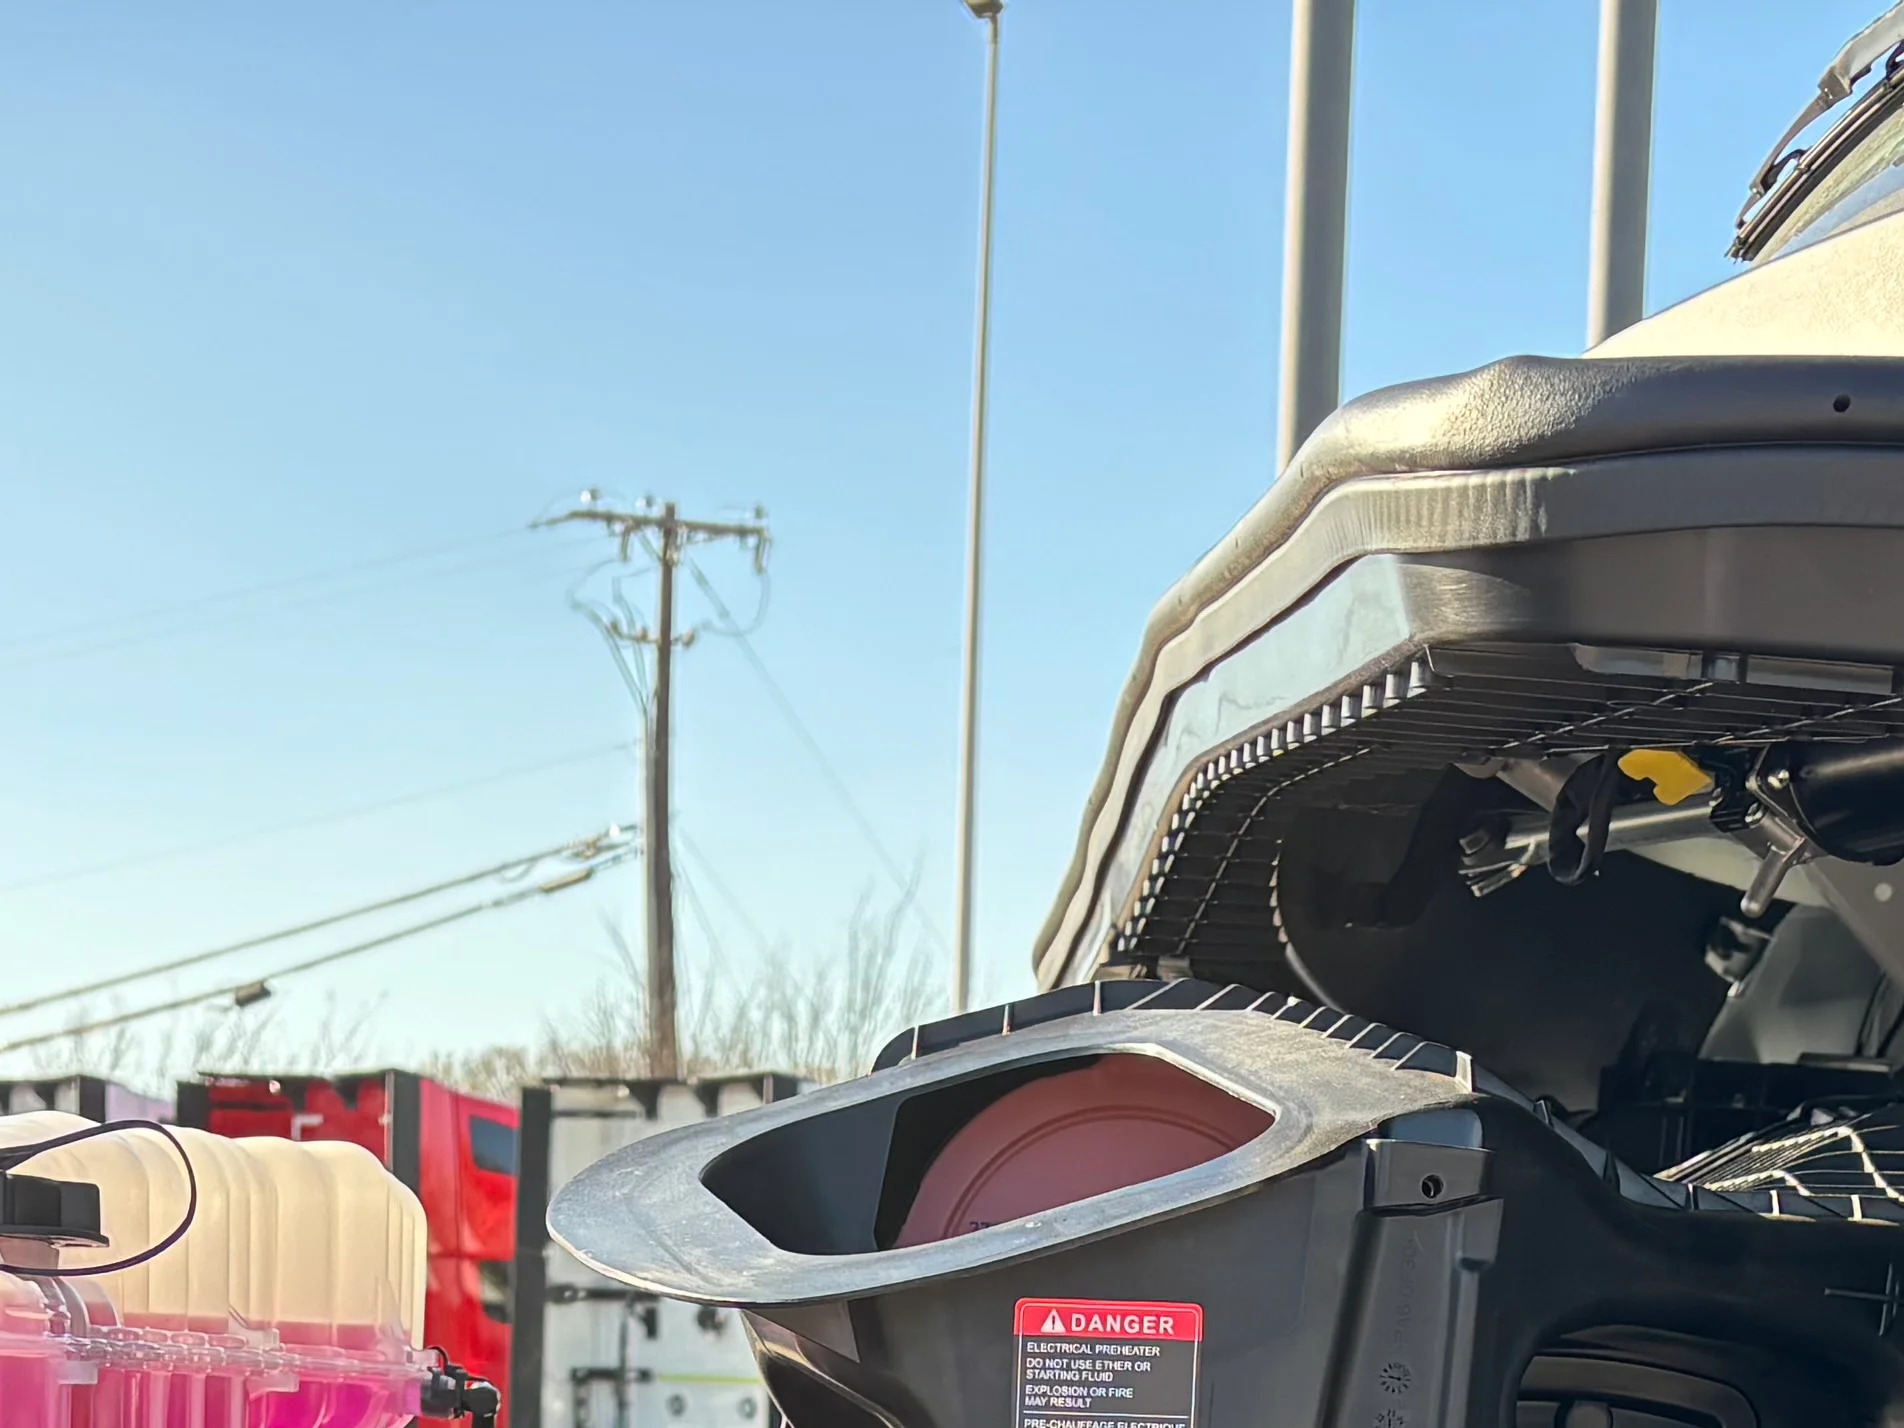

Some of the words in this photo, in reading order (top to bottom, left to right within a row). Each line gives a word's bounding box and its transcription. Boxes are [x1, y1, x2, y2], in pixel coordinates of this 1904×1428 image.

[1071, 1313, 1174, 1335] DANGER
[1027, 1342, 1092, 1354] ELECTRICAL
[1096, 1344, 1160, 1356] PREHEATER
[1026, 1358, 1043, 1368] DO
[1047, 1359, 1068, 1369] NOT
[1071, 1360, 1092, 1369] USE
[1096, 1360, 1131, 1371] ETHER
[1135, 1362, 1151, 1371] OR
[1026, 1369, 1079, 1381] STARTING
[1082, 1371, 1113, 1382] FLUID
[1026, 1385, 1086, 1396] EXPLOSION
[1090, 1387, 1106, 1397] OR
[1109, 1388, 1133, 1398] FIRE
[1025, 1397, 1047, 1406] MAY
[1050, 1397, 1091, 1408] RESULT
